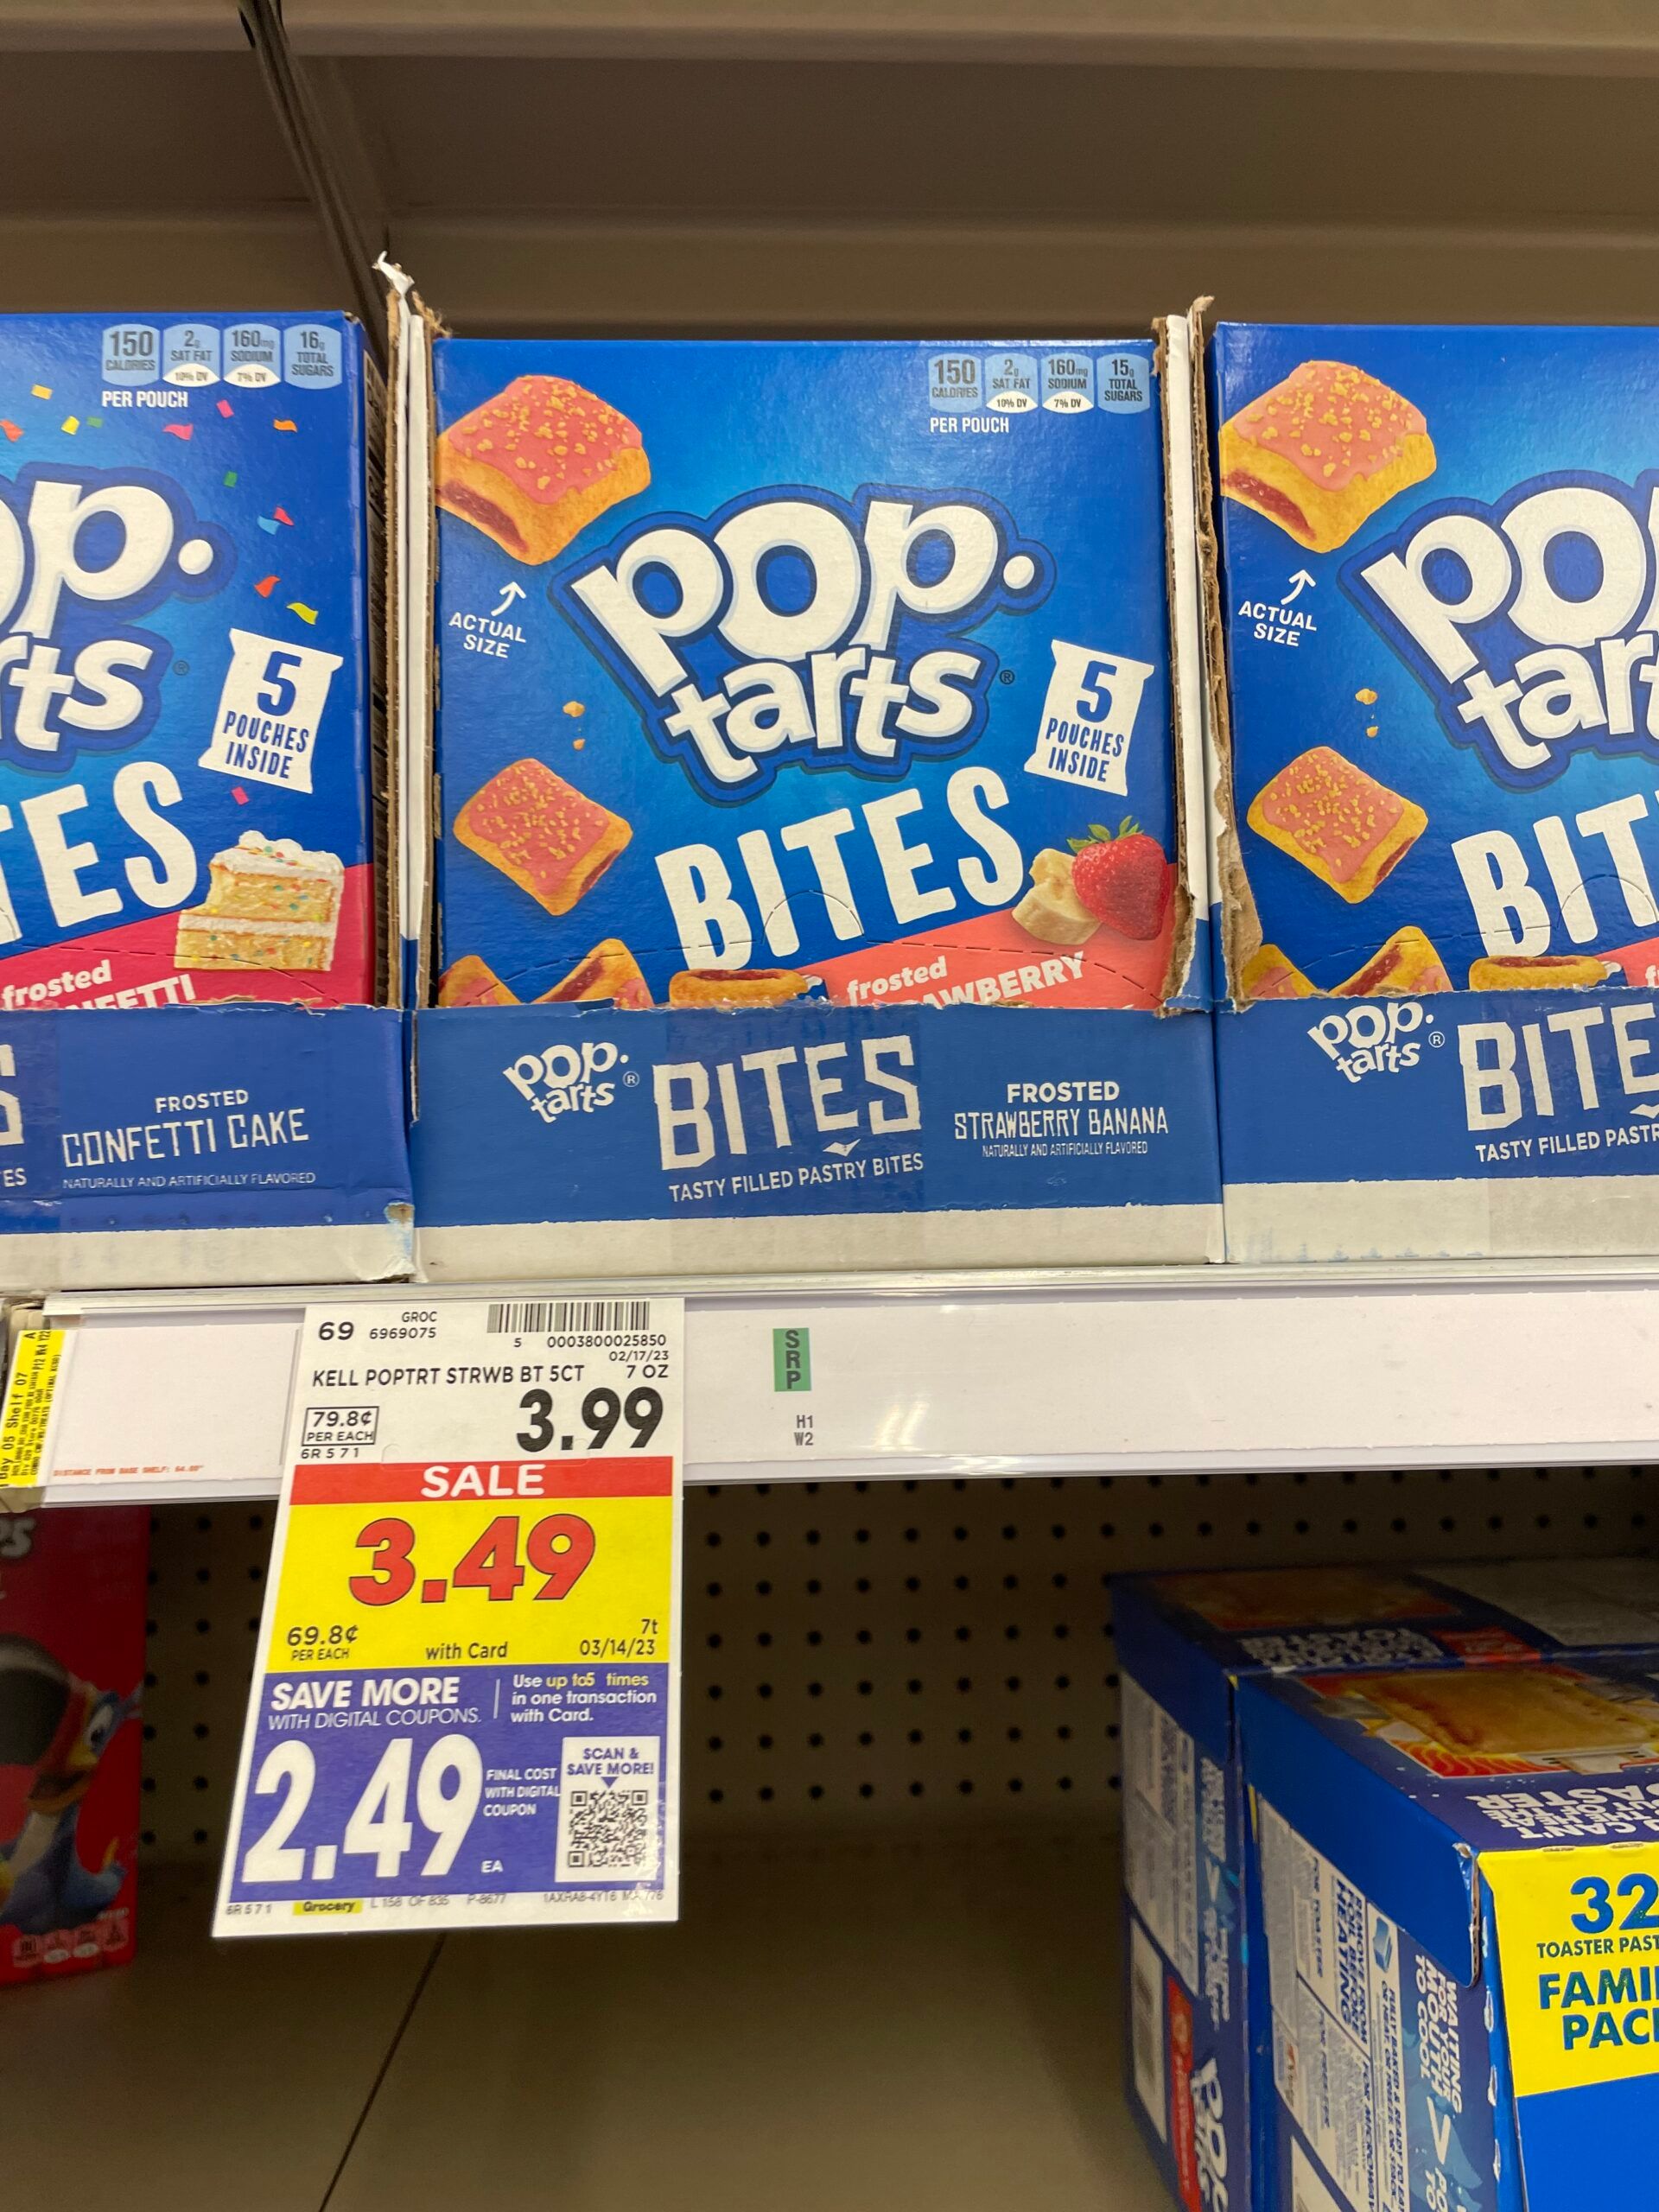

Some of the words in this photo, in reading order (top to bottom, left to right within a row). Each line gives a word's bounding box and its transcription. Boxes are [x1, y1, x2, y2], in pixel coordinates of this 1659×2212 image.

[110, 331, 153, 356] 150
[105, 359, 156, 372] CALORIES
[170, 350, 190, 361] SAT
[193, 350, 213, 361] FAT
[231, 351, 273, 362] SODIUM
[297, 353, 327, 364] TOTAL
[195, 372, 207, 381] DV
[255, 372, 266, 382] DV
[291, 365, 334, 377] SUGARS
[934, 359, 976, 385] 150
[932, 387, 978, 398] CALORIES
[993, 378, 1010, 389] SAT
[1014, 378, 1030, 389] FAT
[1048, 378, 1087, 390] SODIUM
[1109, 378, 1137, 390] TOTAL
[102, 391, 133, 407] PER
[137, 391, 188, 407] POUCH
[996, 398, 1014, 408] 10%
[1016, 398, 1027, 408] DV
[1054, 398, 1068, 408] 7%
[1071, 398, 1081, 408] DV
[1104, 391, 1142, 402] SUGARS
[931, 417, 957, 432] PER
[963, 417, 1009, 432] POUCH
[1238, 601, 1317, 631] ACTUAL
[448, 612, 527, 645] ACTUAL
[1253, 623, 1300, 647] SIZE
[463, 633, 511, 659] SIZE
[257, 651, 303, 716] 5
[1076, 660, 1117, 723] 5
[666, 645, 982, 784] tarts
[223, 711, 308, 753] POUCHES
[1045, 721, 1125, 759] POUCHES
[226, 741, 294, 779] INSIDE
[1048, 747, 1109, 784] INSIDE
[655, 766, 1024, 971] BITES
[1452, 793, 1659, 957] BIT
[3, 959, 112, 1009] frosted
[847, 956, 948, 1006] frosted
[1336, 1042, 1421, 1084] tarts
[156, 1090, 249, 1113] FROSTED
[531, 1081, 615, 1123] tarts
[1007, 1081, 1120, 1103] FROSTED
[652, 1035, 921, 1170] BITES
[955, 1108, 1081, 1140] STRAWBERRY
[1089, 1106, 1168, 1136] BANANA
[62, 1118, 216, 1167] CONFETTI
[227, 1109, 309, 1149] CAKE
[1475, 1140, 1533, 1163] TASTY
[1539, 1131, 1600, 1154] FILLED
[982, 1144, 1028, 1158] NATURALLY
[1031, 1144, 1048, 1156] AND
[1050, 1142, 1103, 1156] ARTIFICIALLY
[1105, 1141, 1147, 1155] FLAVORED
[63, 1175, 134, 1189] NATURALLY
[138, 1175, 164, 1187] AND
[168, 1173, 248, 1186] ARTIFICIALLY
[252, 1172, 315, 1184] FLAVORED
[670, 1179, 725, 1202] TASTY
[732, 1171, 792, 1194] FILLED
[799, 1160, 866, 1185] PASTRY
[874, 1154, 923, 1176] BITES
[402, 1311, 437, 1323] GROC
[319, 1321, 354, 1340] 69
[369, 1327, 436, 1339] 6969075
[514, 1338, 522, 1348] 5
[547, 1335, 666, 1349] 0003800025850
[609, 1350, 669, 1362] 02/17/23
[15, 1372, 28, 1386] 07
[313, 1370, 359, 1387] KELL
[365, 1368, 441, 1386] POPTRT
[446, 1365, 513, 1384] STRWB
[520, 1365, 543, 1382] BT
[550, 1364, 585, 1382] 5CT
[626, 1365, 636, 1378] 7
[642, 1364, 669, 1378] OZ
[5, 1393, 23, 1428] Shelf
[313, 1410, 372, 1427] 79.8¢
[516, 1386, 664, 1452] 3.99
[796, 1414, 813, 1428] H1
[2, 1436, 16, 1450] 05
[307, 1432, 332, 1442] PER
[337, 1431, 374, 1441] EACH
[794, 1432, 814, 1446] W2
[421, 1464, 546, 1497] SALE
[348, 1513, 595, 1606] 3.49
[287, 1625, 359, 1647] 69.8¢
[641, 1618, 658, 1635] 7t
[290, 1648, 316, 1662] PER
[317, 1646, 350, 1661] EACH
[426, 1643, 461, 1660] with
[469, 1642, 508, 1659] Card
[580, 1639, 655, 1657] 03/14/23
[512, 1674, 543, 1688] Use
[546, 1675, 568, 1690] up
[606, 1673, 649, 1686] times
[271, 1679, 351, 1711] SAVE
[361, 1676, 460, 1707] MORE
[512, 1692, 527, 1705] in
[531, 1694, 563, 1705] one
[566, 1690, 657, 1704] transaction
[268, 1713, 310, 1731] WITH
[315, 1711, 382, 1729] DIGITAL
[385, 1707, 481, 1726] COUPONS.
[511, 1709, 543, 1722] with
[548, 1707, 594, 1722] Card.
[582, 1746, 625, 1760] SCAN
[628, 1746, 639, 1759] &
[486, 1768, 522, 1782] FINAL
[524, 1767, 556, 1780] COST
[566, 1763, 603, 1777] SAVE
[607, 1762, 654, 1776] MORE!
[485, 1786, 515, 1799] WITH
[517, 1785, 561, 1798] DIGITAL
[244, 1733, 483, 1883] 2.49
[483, 1803, 536, 1817] COUPON
[1482, 1807, 1554, 1820] THE
[1560, 1804, 1606, 1815] OF
[1589, 1811, 1651, 1823] THE
[1501, 1815, 1583, 1827] HEAT
[1516, 1821, 1637, 1839] CAN'T
[481, 1860, 503, 1874] EA
[303, 1899, 355, 1913] Grocery
[1347, 1889, 1356, 1936] FOIL
[1570, 1872, 1659, 1934] 32
[1355, 1895, 1364, 1983] REMOVE
[1536, 1938, 1614, 1958] TOASTER
[1337, 1878, 1351, 2025] HEATING
[1415, 1954, 1426, 1994] TO
[1349, 1945, 1360, 2036] BEFORE
[1437, 1971, 1447, 2022] FOR
[1359, 1986, 1368, 2044] FROM
[1426, 1958, 1446, 2097] MOUTH
[1418, 2000, 1430, 2079] COOL
[1446, 1980, 1462, 2113] WAITING
[1439, 2024, 1451, 2102] YOUR
